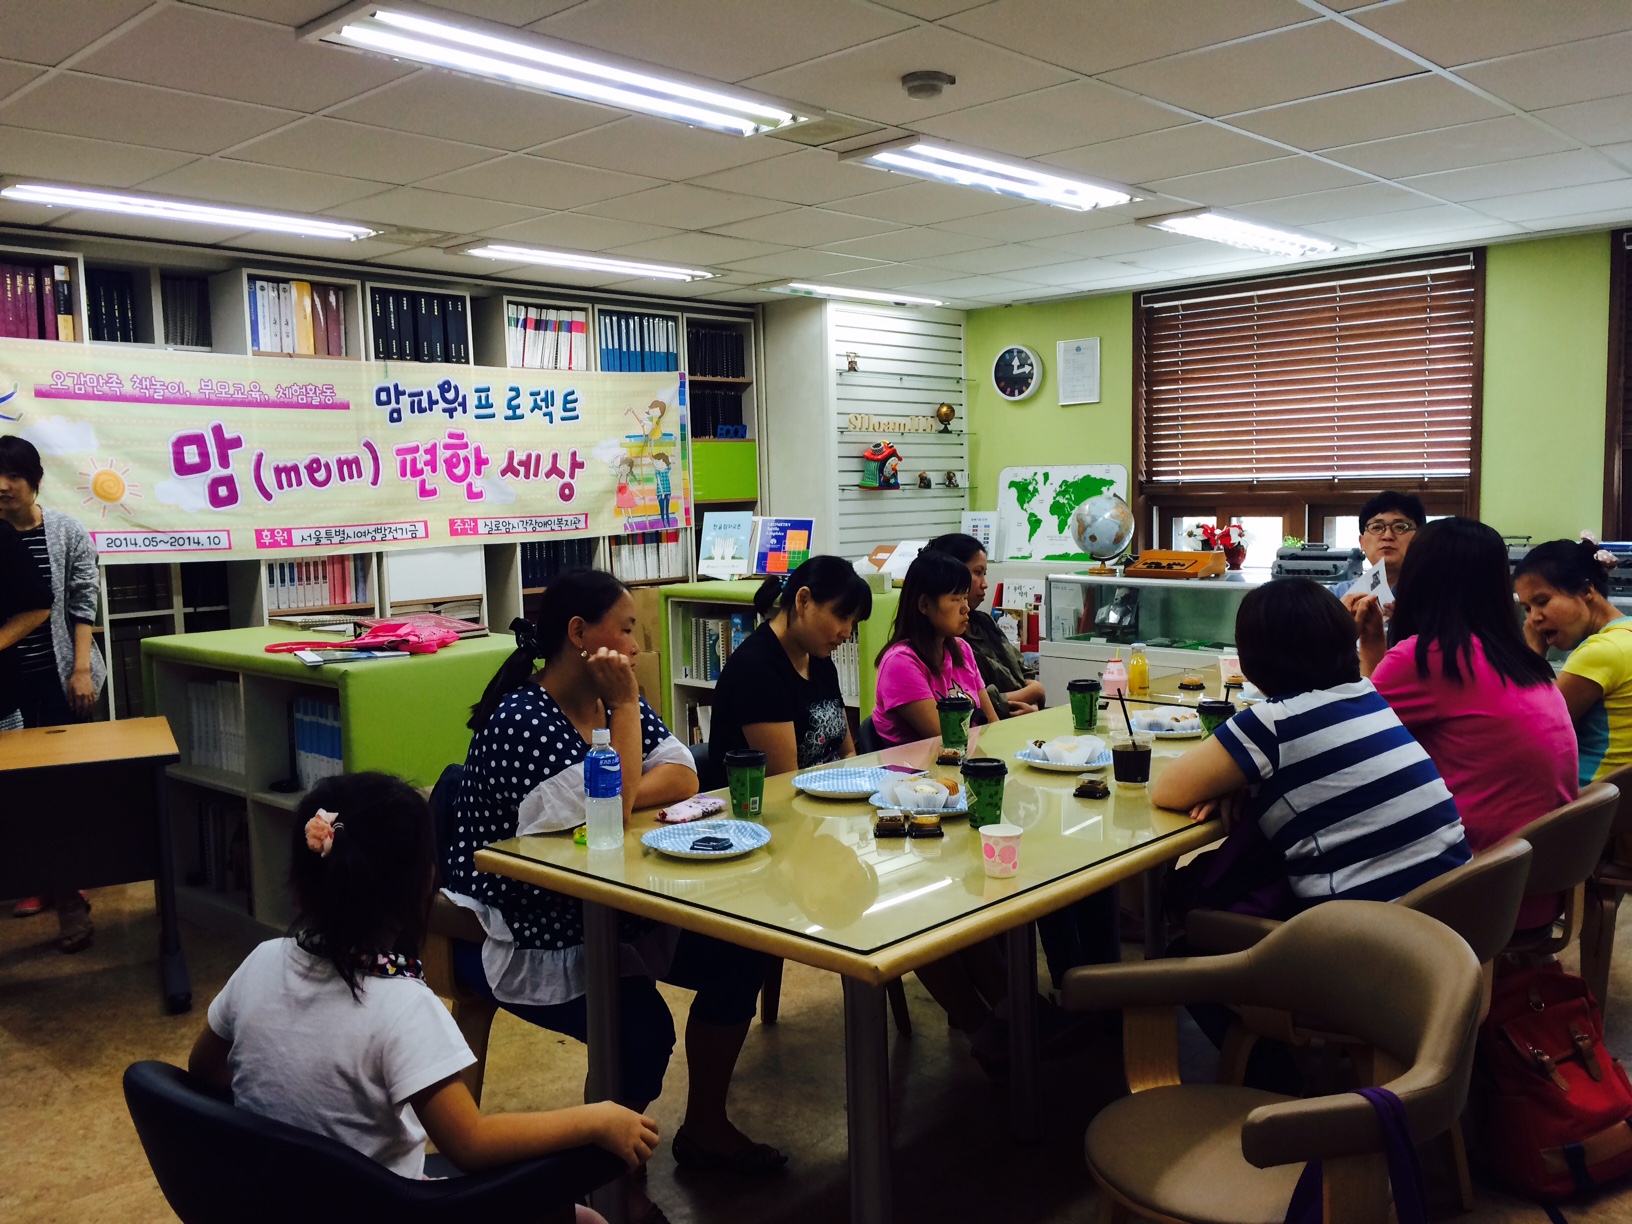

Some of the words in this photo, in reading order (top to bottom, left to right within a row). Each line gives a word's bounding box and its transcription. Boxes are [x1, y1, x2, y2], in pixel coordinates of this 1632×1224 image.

[50, 371, 124, 396] 오감만족
[131, 374, 192, 399] 책놀이,
[198, 379, 270, 402] 부모교육,
[275, 383, 337, 405] 체험활동
[395, 431, 490, 500] 편한
[500, 450, 586, 502] 세상
[453, 519, 475, 534] 주관
[483, 516, 582, 534] 실로암시각장애인복지관
[105, 534, 221, 548] 2014.05~2014.10
[261, 529, 288, 546] 후원
[300, 524, 419, 545] 서울특별시여성발전기금
